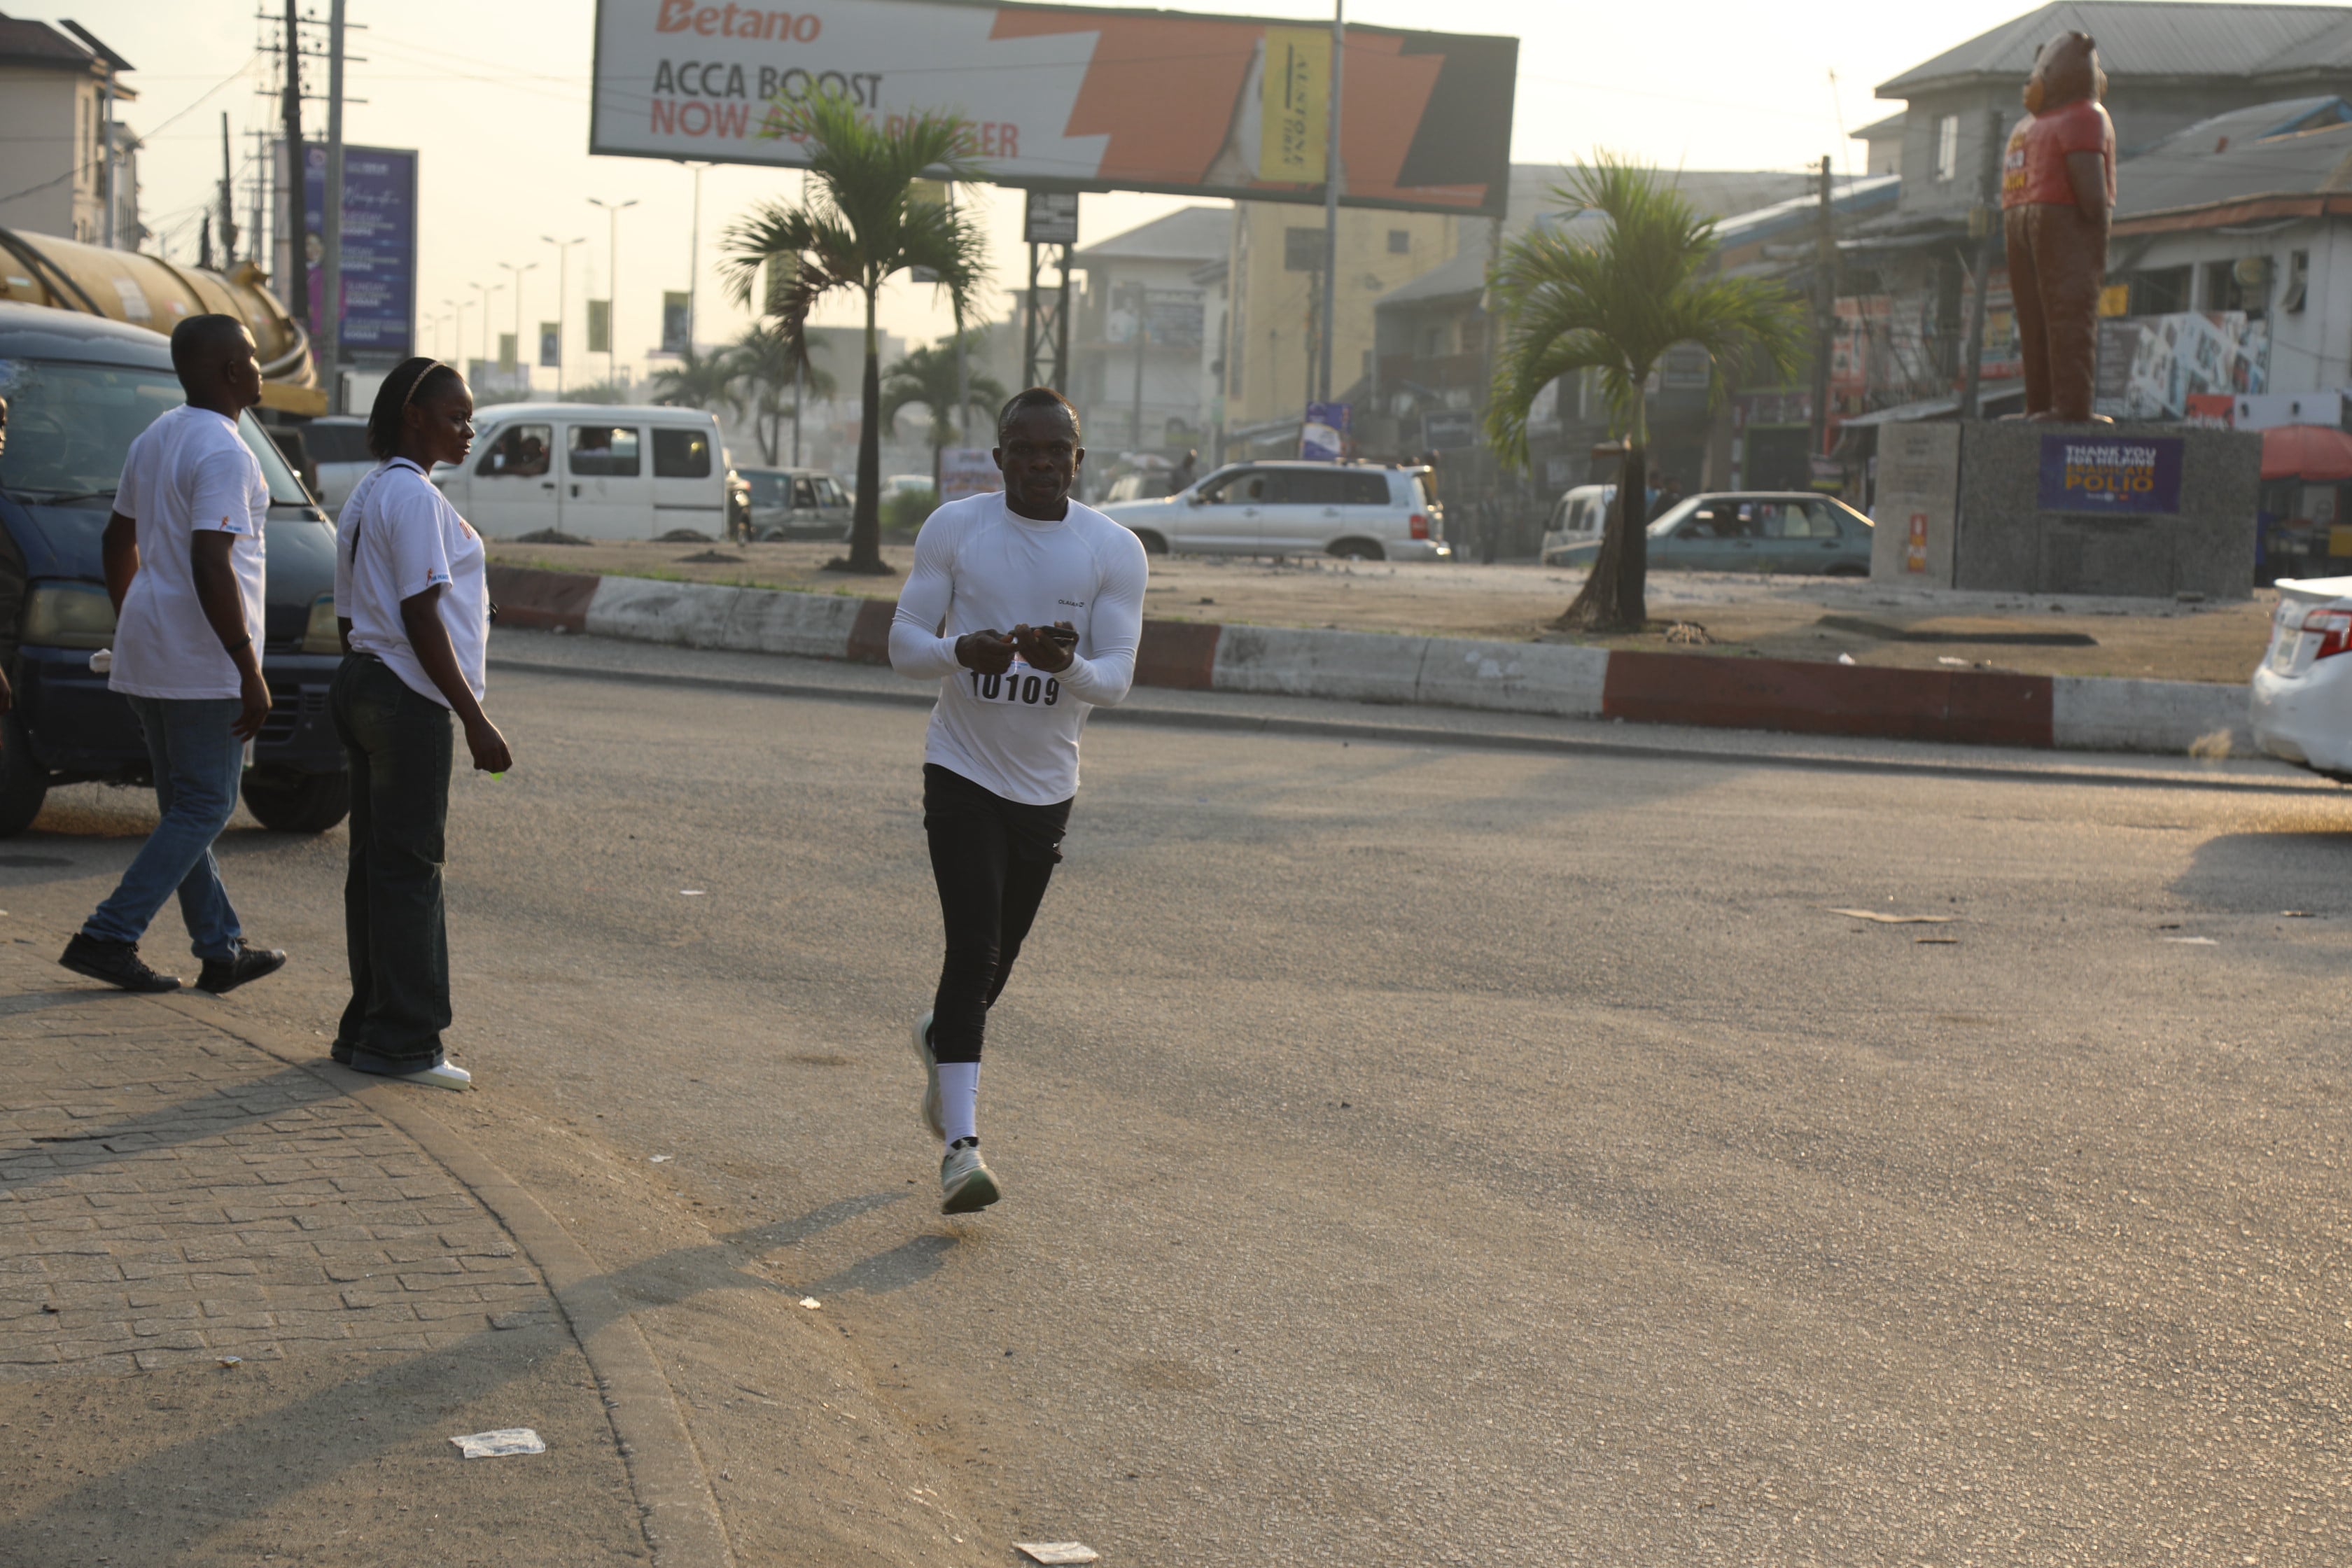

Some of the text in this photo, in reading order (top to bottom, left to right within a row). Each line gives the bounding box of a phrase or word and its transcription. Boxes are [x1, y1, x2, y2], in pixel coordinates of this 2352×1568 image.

[656, 0, 822, 43] Betano
[653, 59, 883, 108] ACCA BOOST
[650, 99, 750, 139] NOW
[2065, 444, 2157, 457] THANK YOU
[2096, 457, 2155, 467] HELPING
[2066, 466, 2154, 476] ERADICATE
[2066, 475, 2154, 492] POLIO
[971, 671, 1060, 706] 10109
